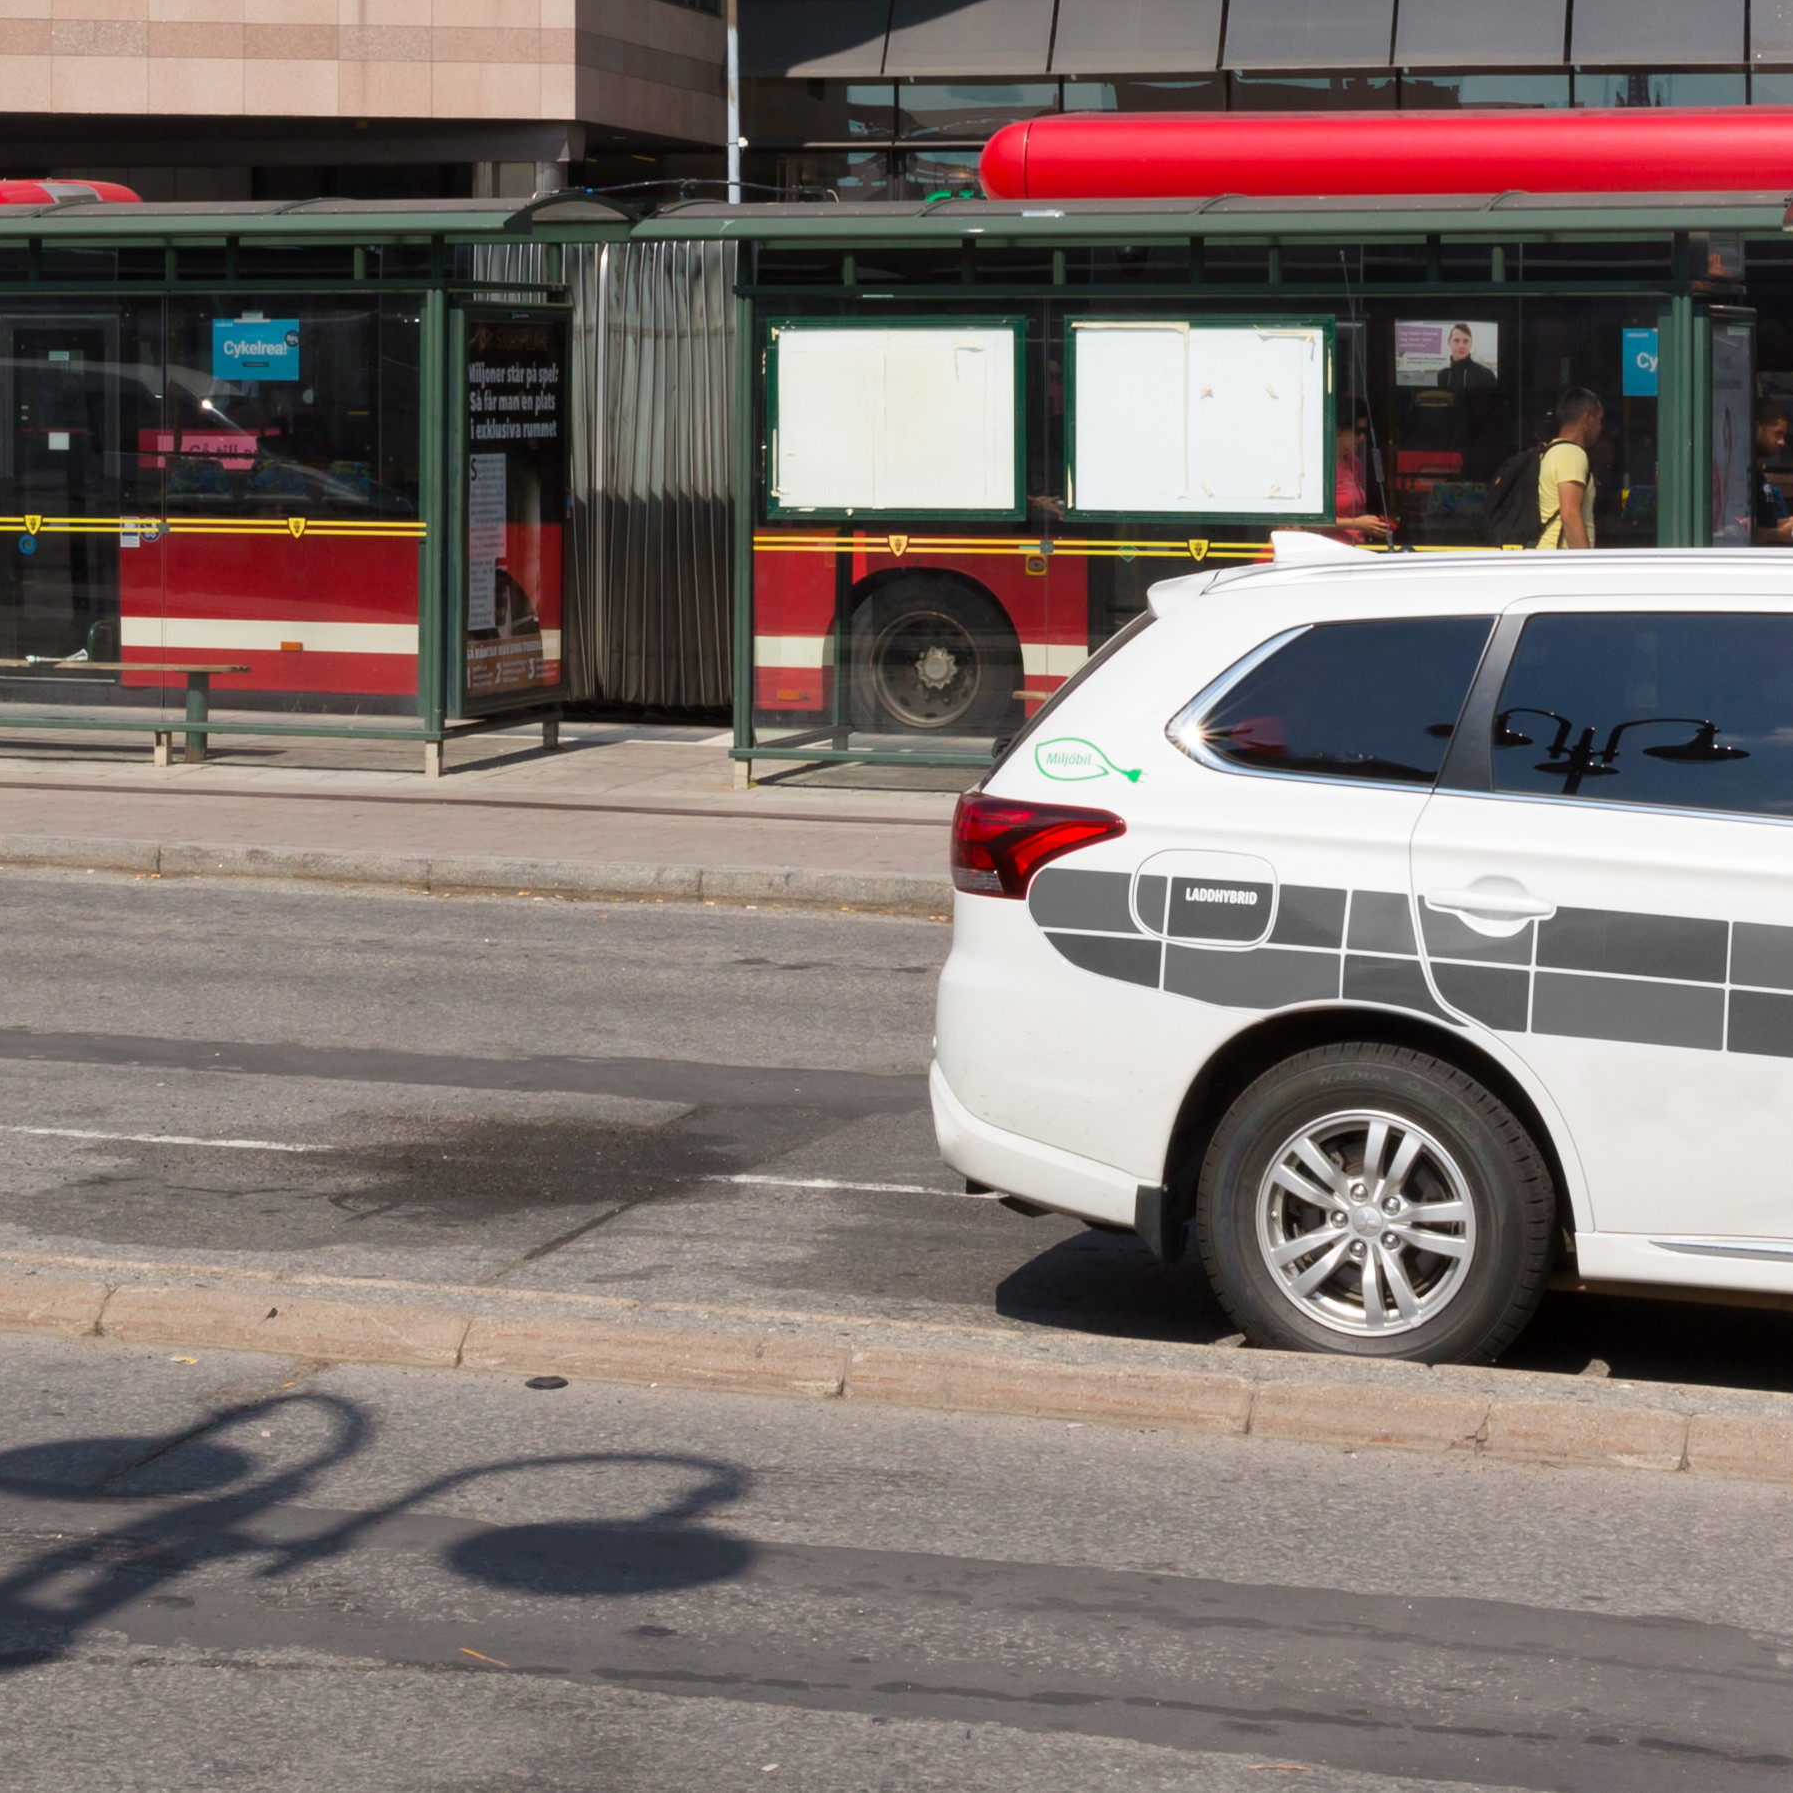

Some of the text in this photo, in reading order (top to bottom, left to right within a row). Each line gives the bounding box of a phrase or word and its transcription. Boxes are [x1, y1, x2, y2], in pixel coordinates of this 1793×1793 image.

[223, 340, 287, 359] Cykelrea!
[469, 361, 505, 389] Miljoner
[507, 361, 524, 383] står
[527, 361, 537, 389] på
[470, 389, 482, 412] Så
[498, 395, 520, 411] man
[522, 395, 533, 410] en
[535, 390, 556, 416] plats
[476, 417, 521, 439] exklusiva
[523, 420, 557, 438] rummet
[1046, 752, 1092, 767] Miljöbil
[1185, 887, 1258, 905] LADDHYBRID
